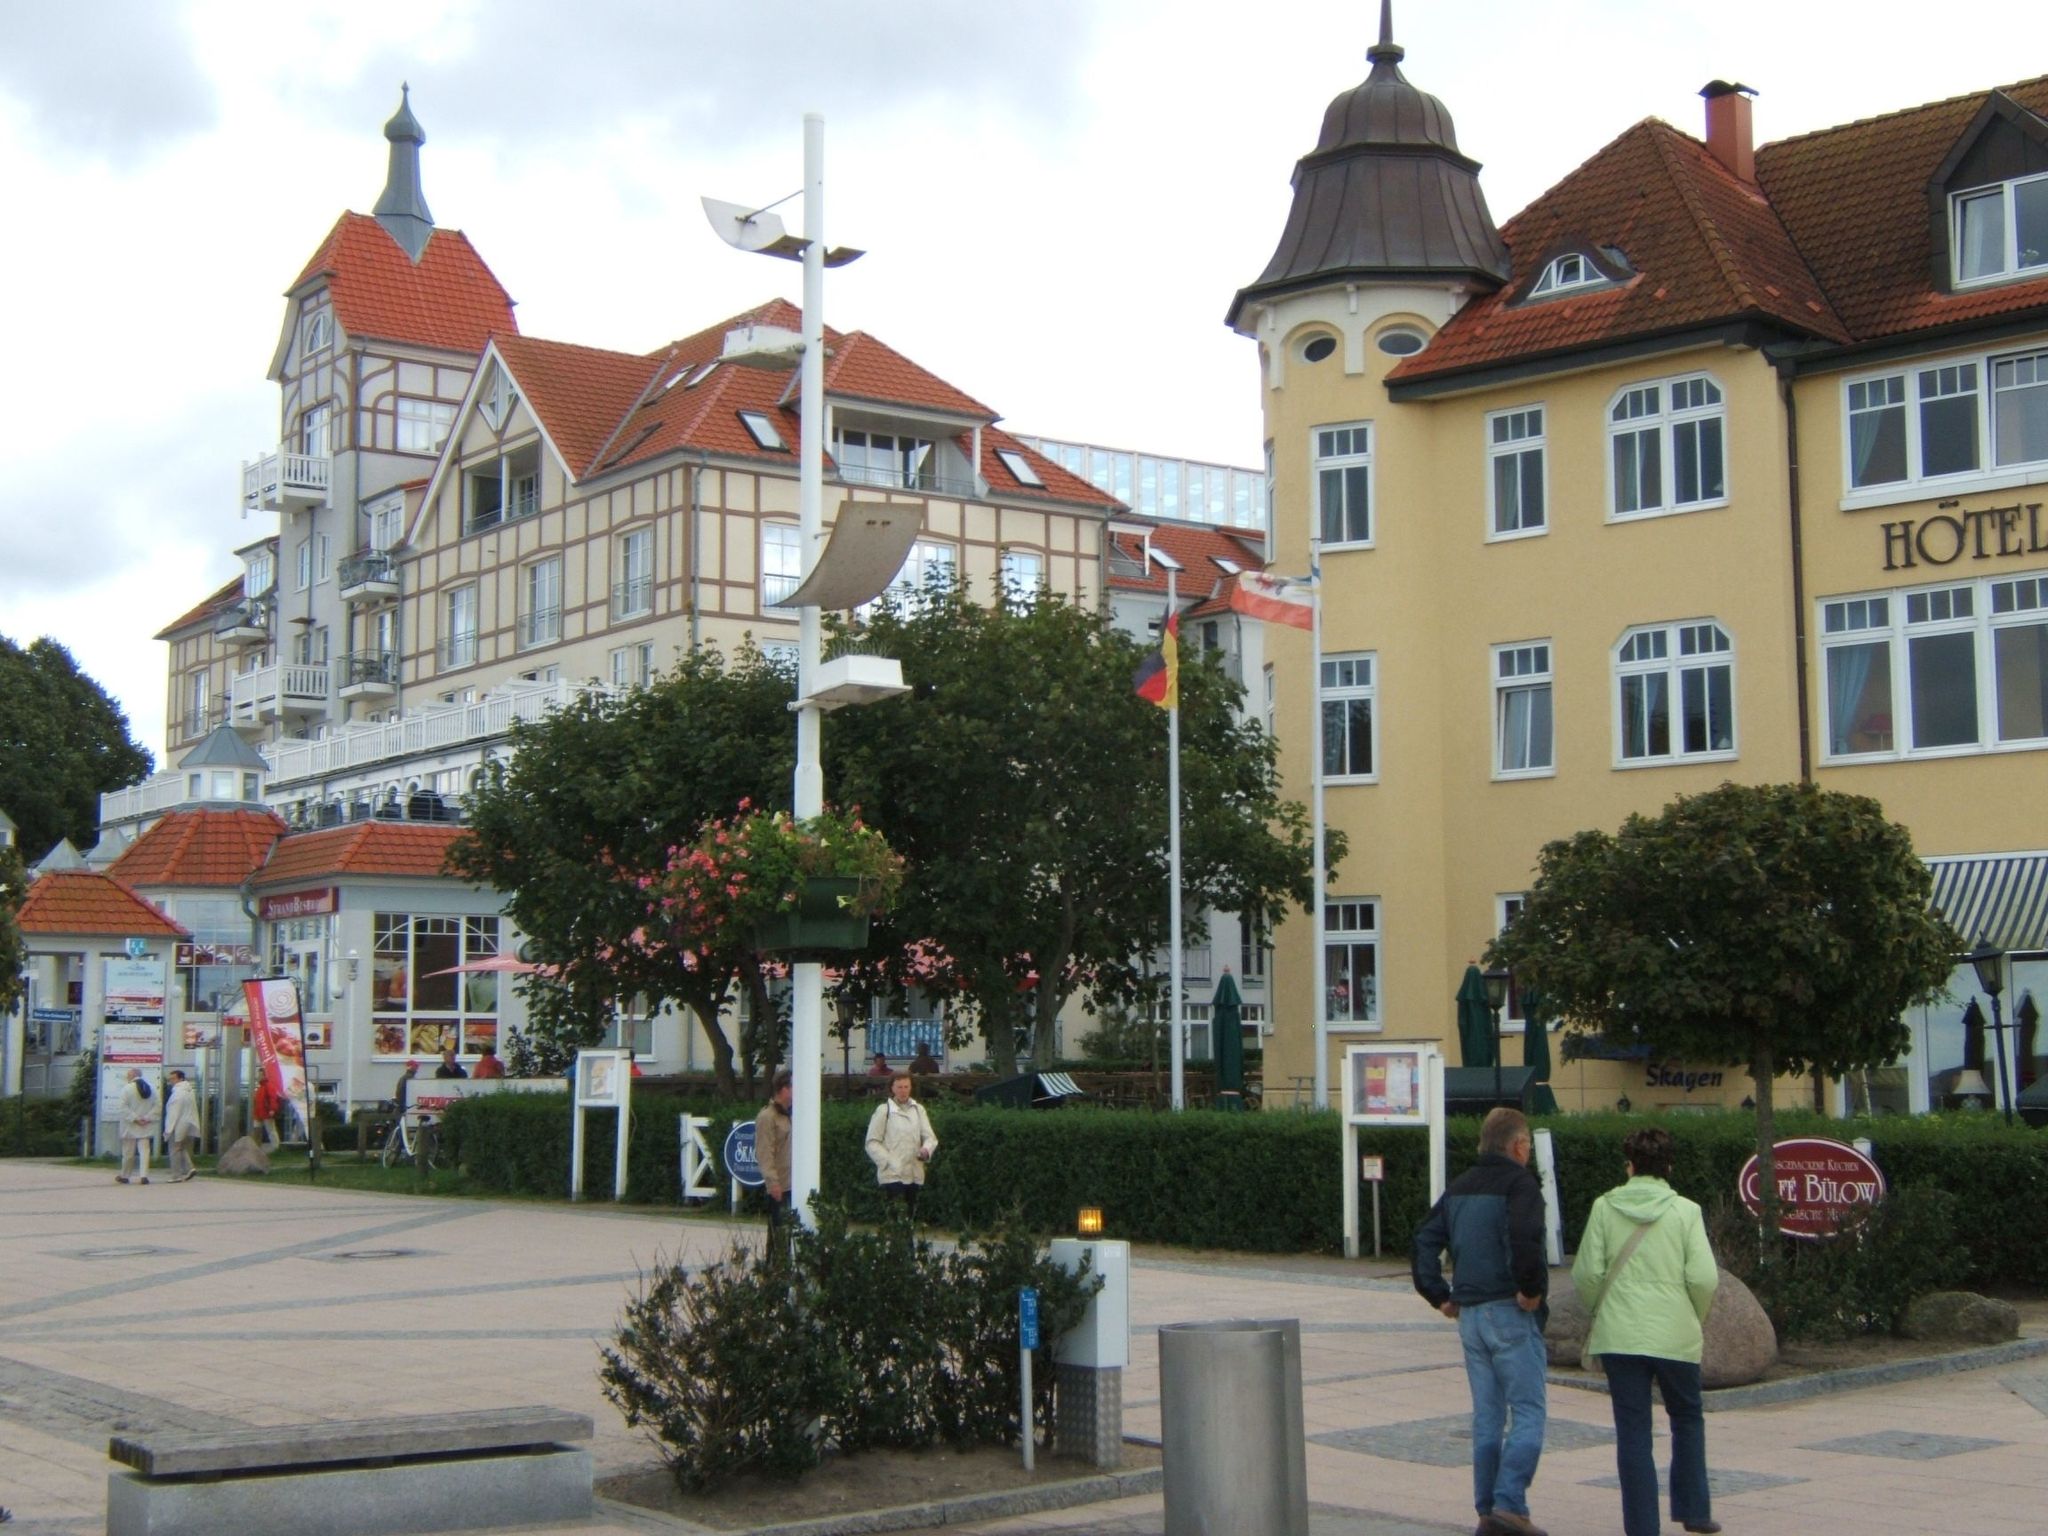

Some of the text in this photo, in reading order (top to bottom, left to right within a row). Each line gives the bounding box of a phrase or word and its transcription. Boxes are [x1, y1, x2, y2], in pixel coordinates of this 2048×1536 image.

[1881, 503, 2048, 571] HOTEL
[1646, 1064, 1723, 1093] Skagen
[735, 1141, 759, 1163] SKA
[1747, 1172, 1876, 1205] CFÉ BÜLOW
